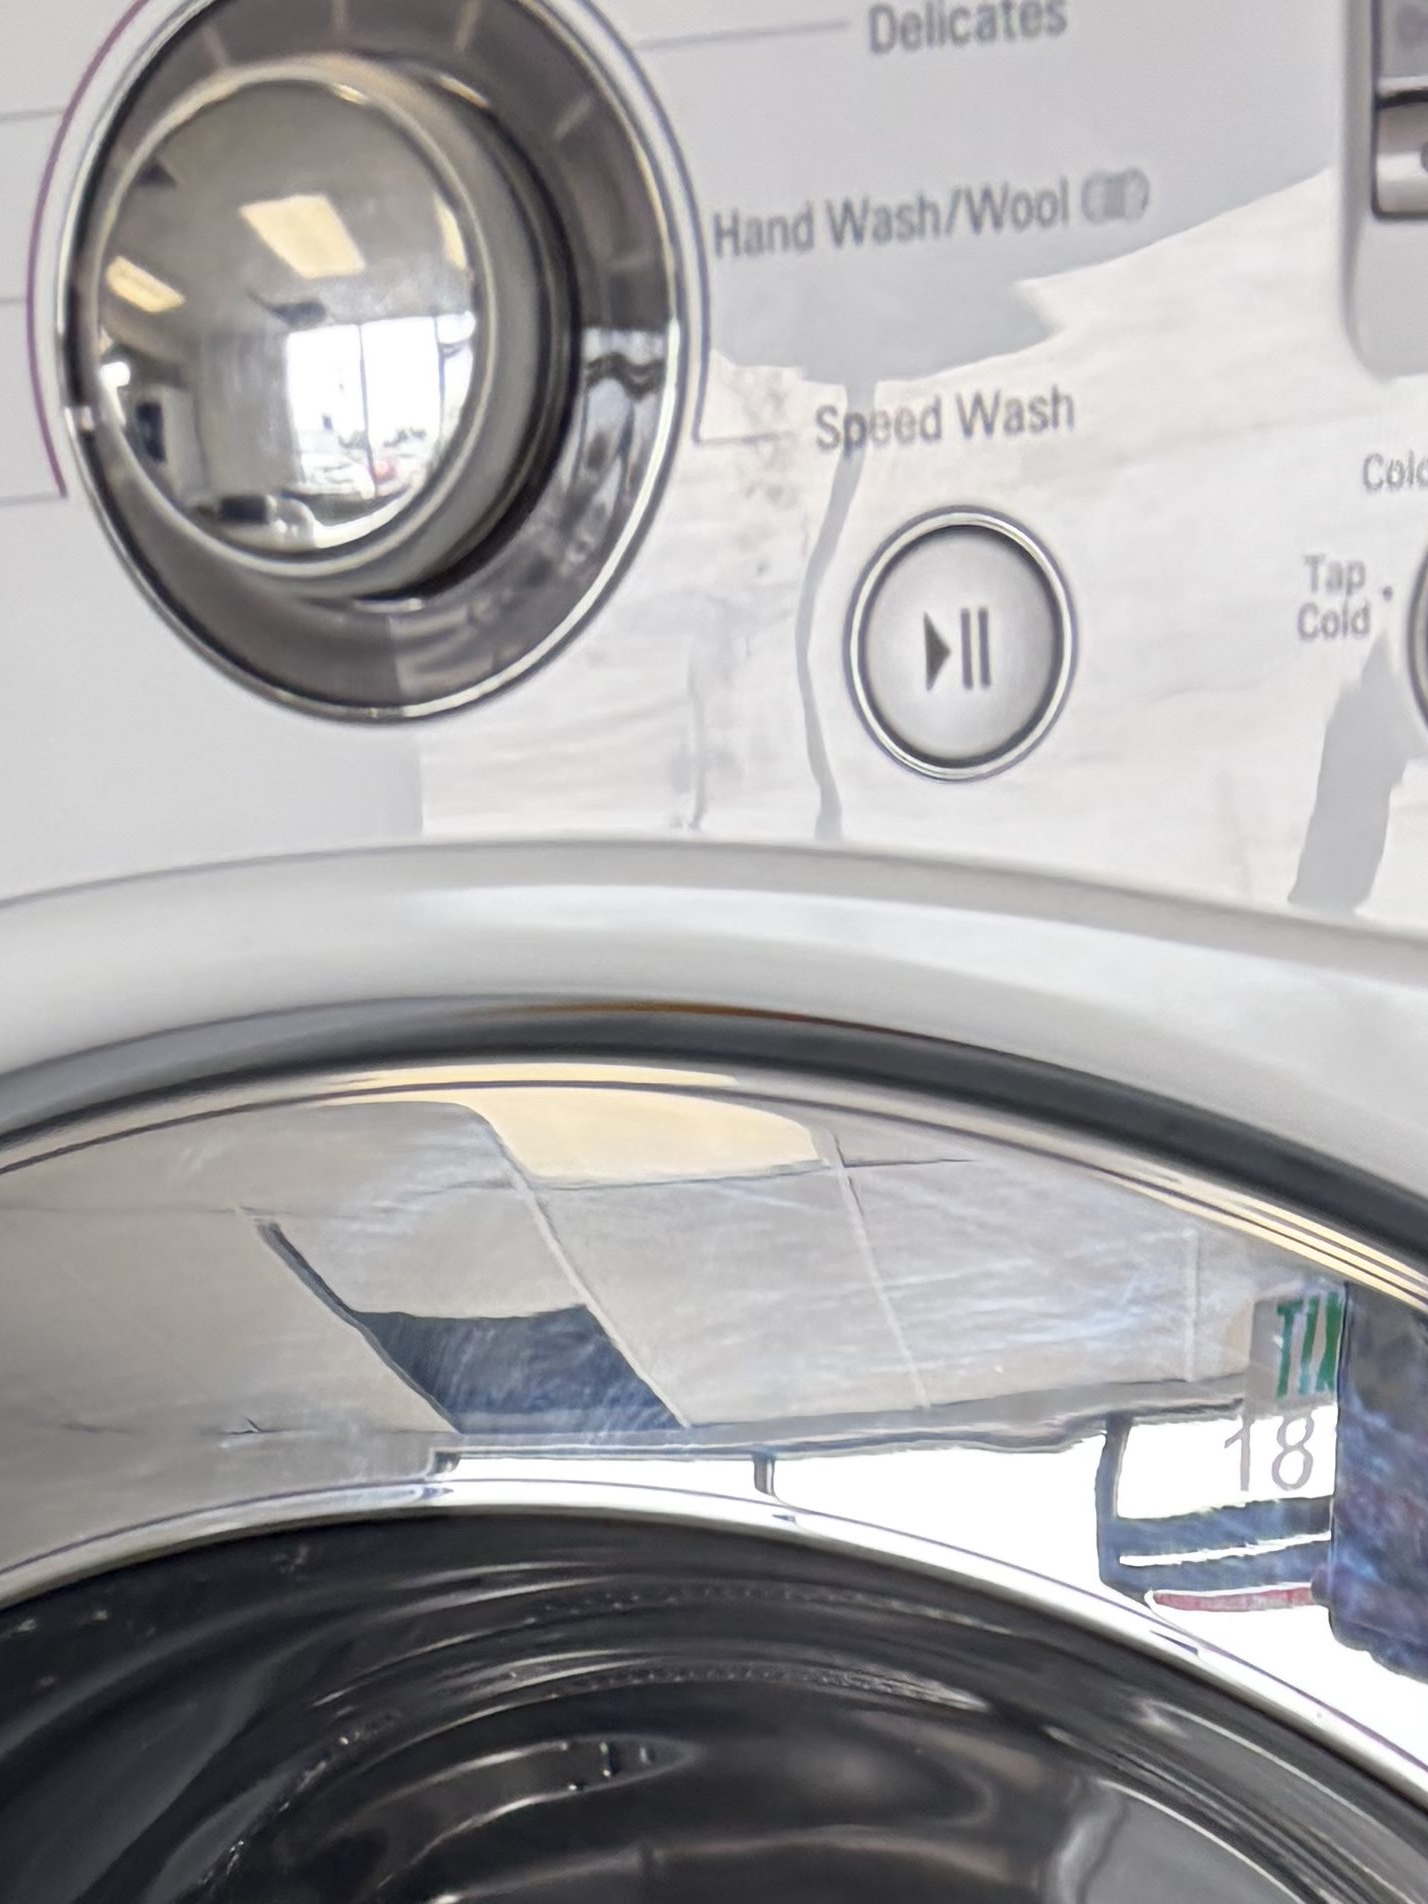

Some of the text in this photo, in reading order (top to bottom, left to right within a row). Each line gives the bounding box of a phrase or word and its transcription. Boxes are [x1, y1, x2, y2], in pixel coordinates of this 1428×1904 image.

[869, 0, 1069, 55] Delicates
[712, 178, 1070, 260] Hand Wash/Wool
[815, 385, 1076, 458] Speed Wash
[1304, 554, 1367, 595] Tap
[1297, 600, 1371, 640] Cold
